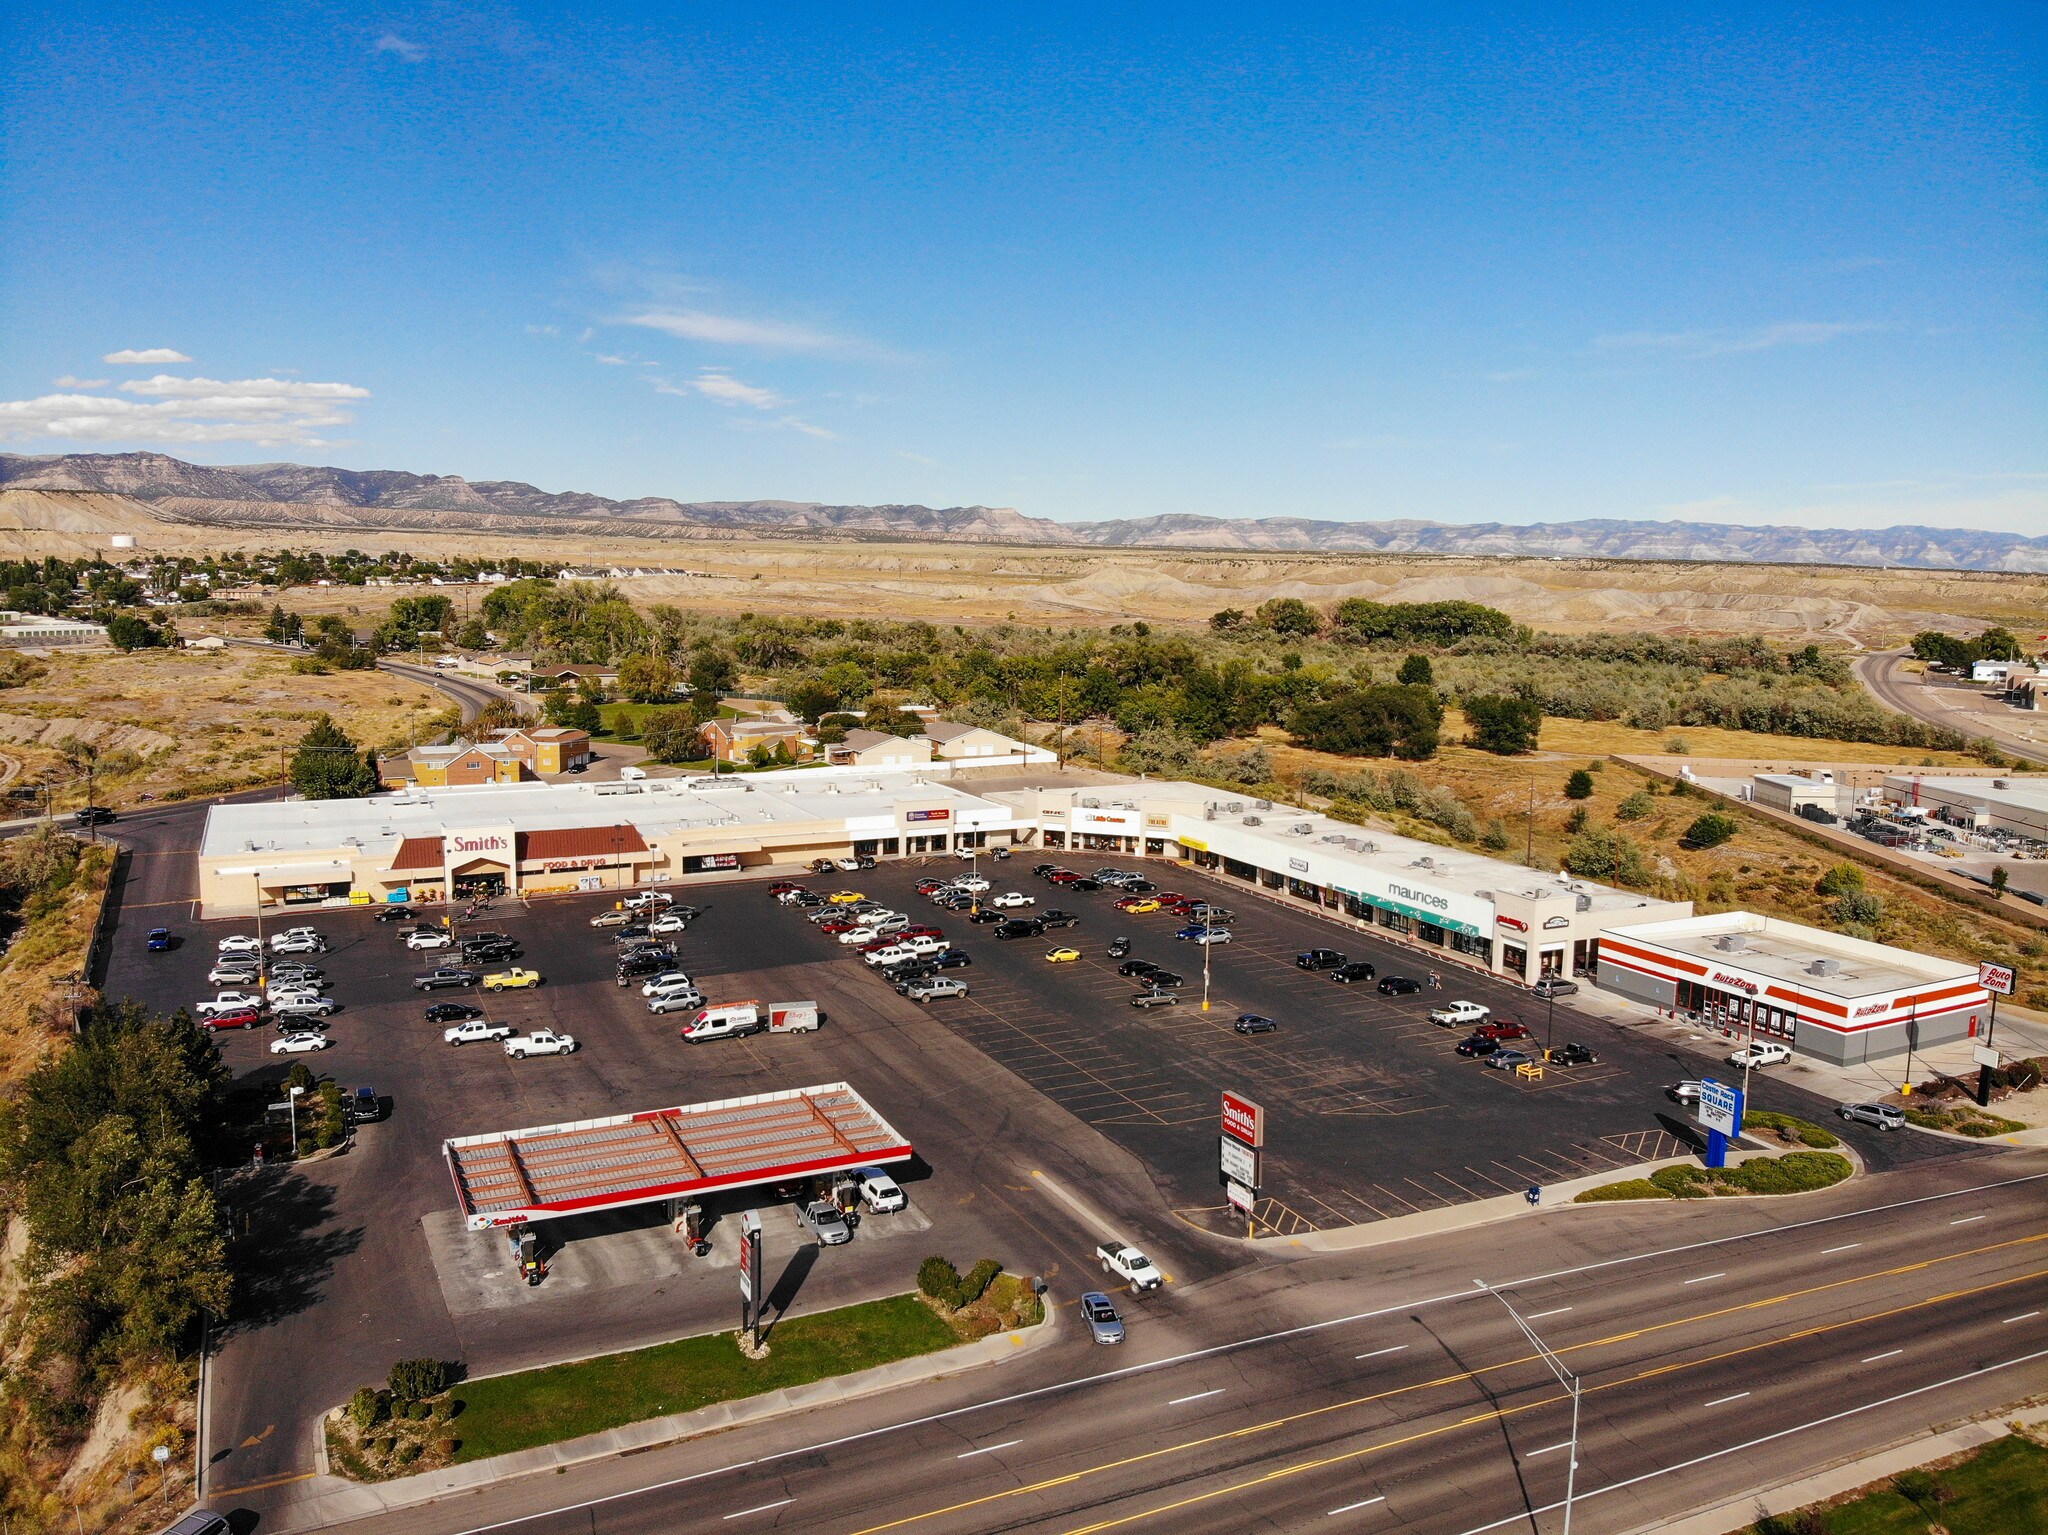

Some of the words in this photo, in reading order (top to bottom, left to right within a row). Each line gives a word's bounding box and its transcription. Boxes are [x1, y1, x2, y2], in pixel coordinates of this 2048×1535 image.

[454, 836, 508, 852] Smith's
[543, 861, 568, 869] FOOD
[580, 858, 606, 867] DRUG
[1388, 883, 1448, 910] maurices
[1988, 967, 2011, 981] Auto
[1983, 976, 2007, 989] Zone
[1853, 1002, 1889, 1018] AutoZone
[1701, 1083, 1719, 1095] Castle
[1720, 1091, 1734, 1102] Rock
[1701, 1091, 1733, 1112] SQUARE
[1223, 1100, 1254, 1130] Smith's
[1224, 1118, 1236, 1128] FOOD
[1240, 1126, 1253, 1138] DRUG
[493, 1215, 528, 1226] Smith's
